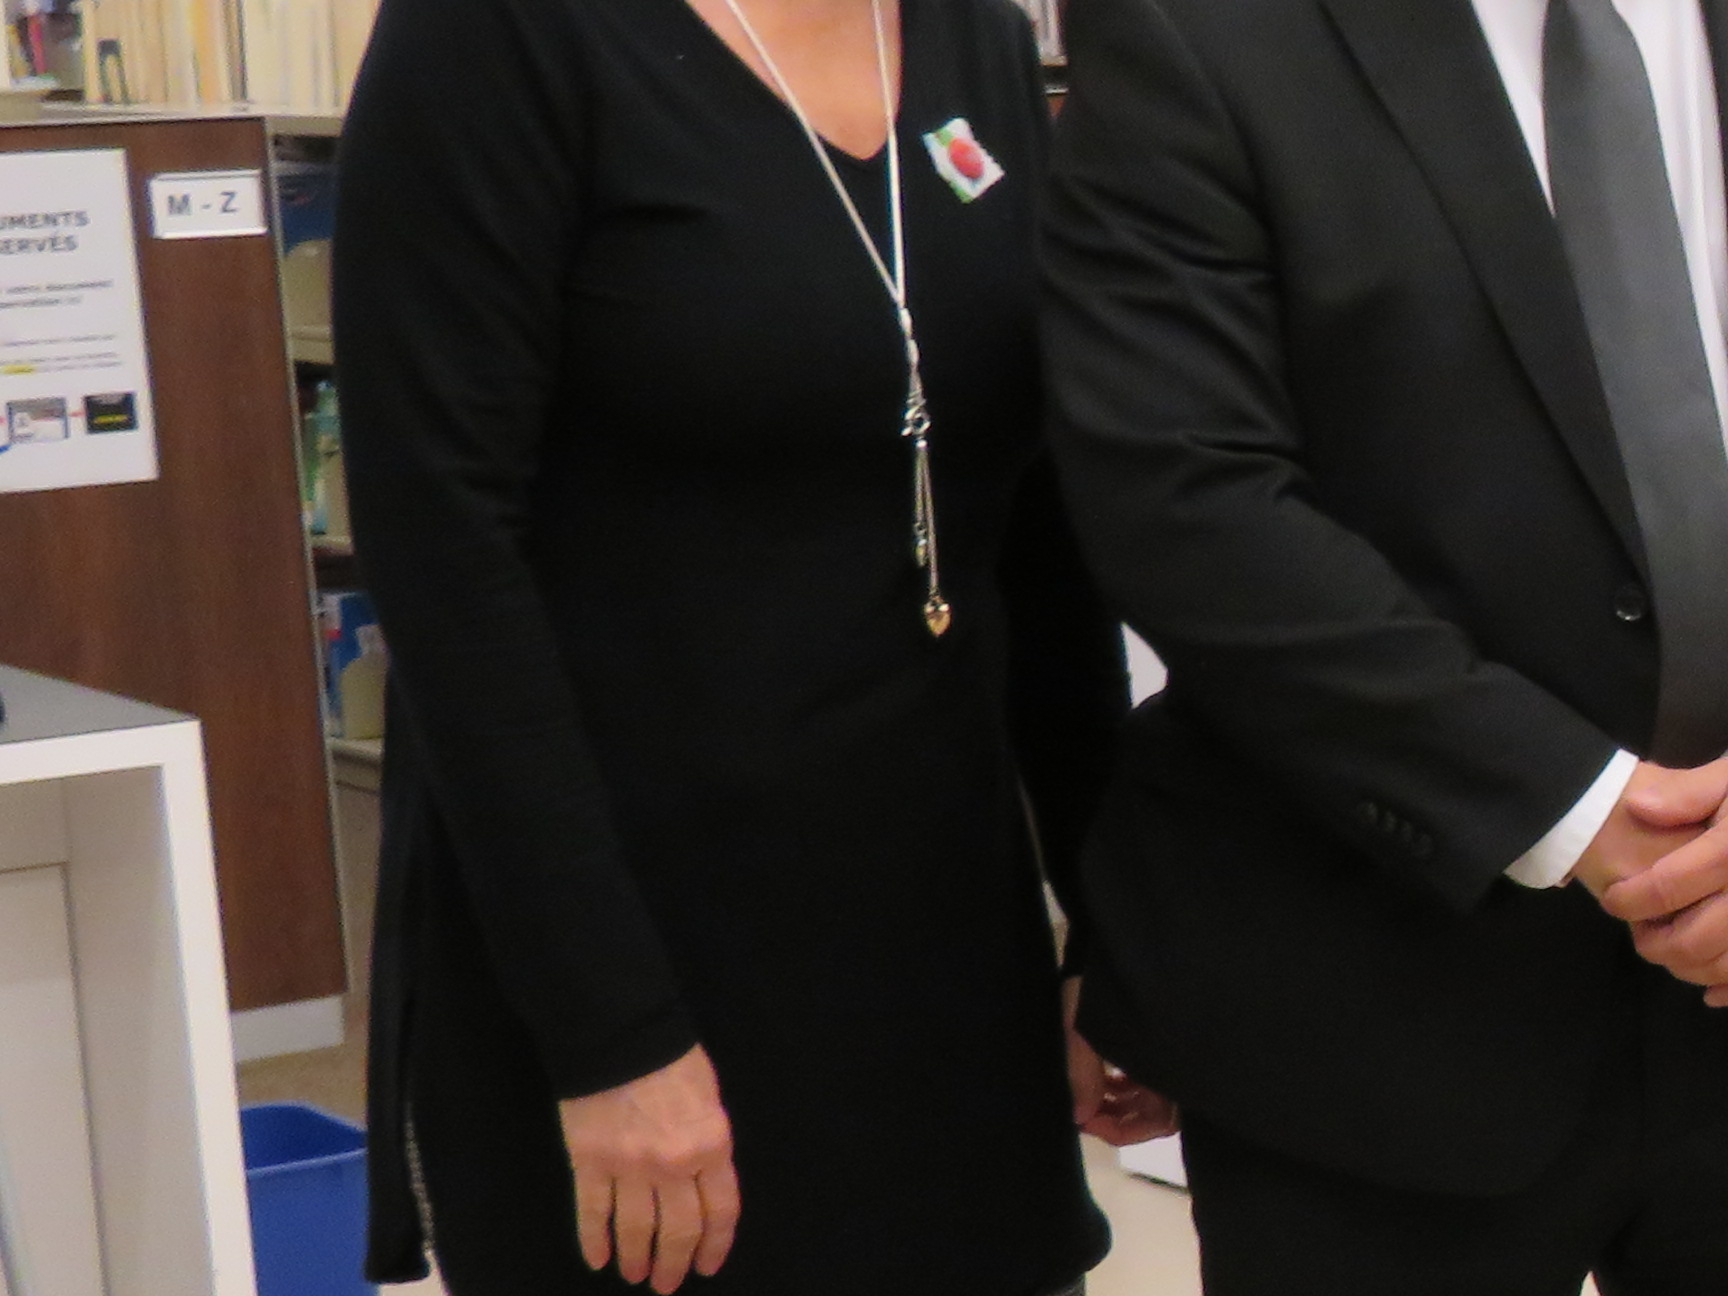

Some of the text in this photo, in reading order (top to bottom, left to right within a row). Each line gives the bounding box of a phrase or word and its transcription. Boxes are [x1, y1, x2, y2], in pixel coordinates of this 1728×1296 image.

[168, 193, 192, 215] M
[220, 190, 238, 213] Z
[0, 233, 78, 255] ERVÉS
